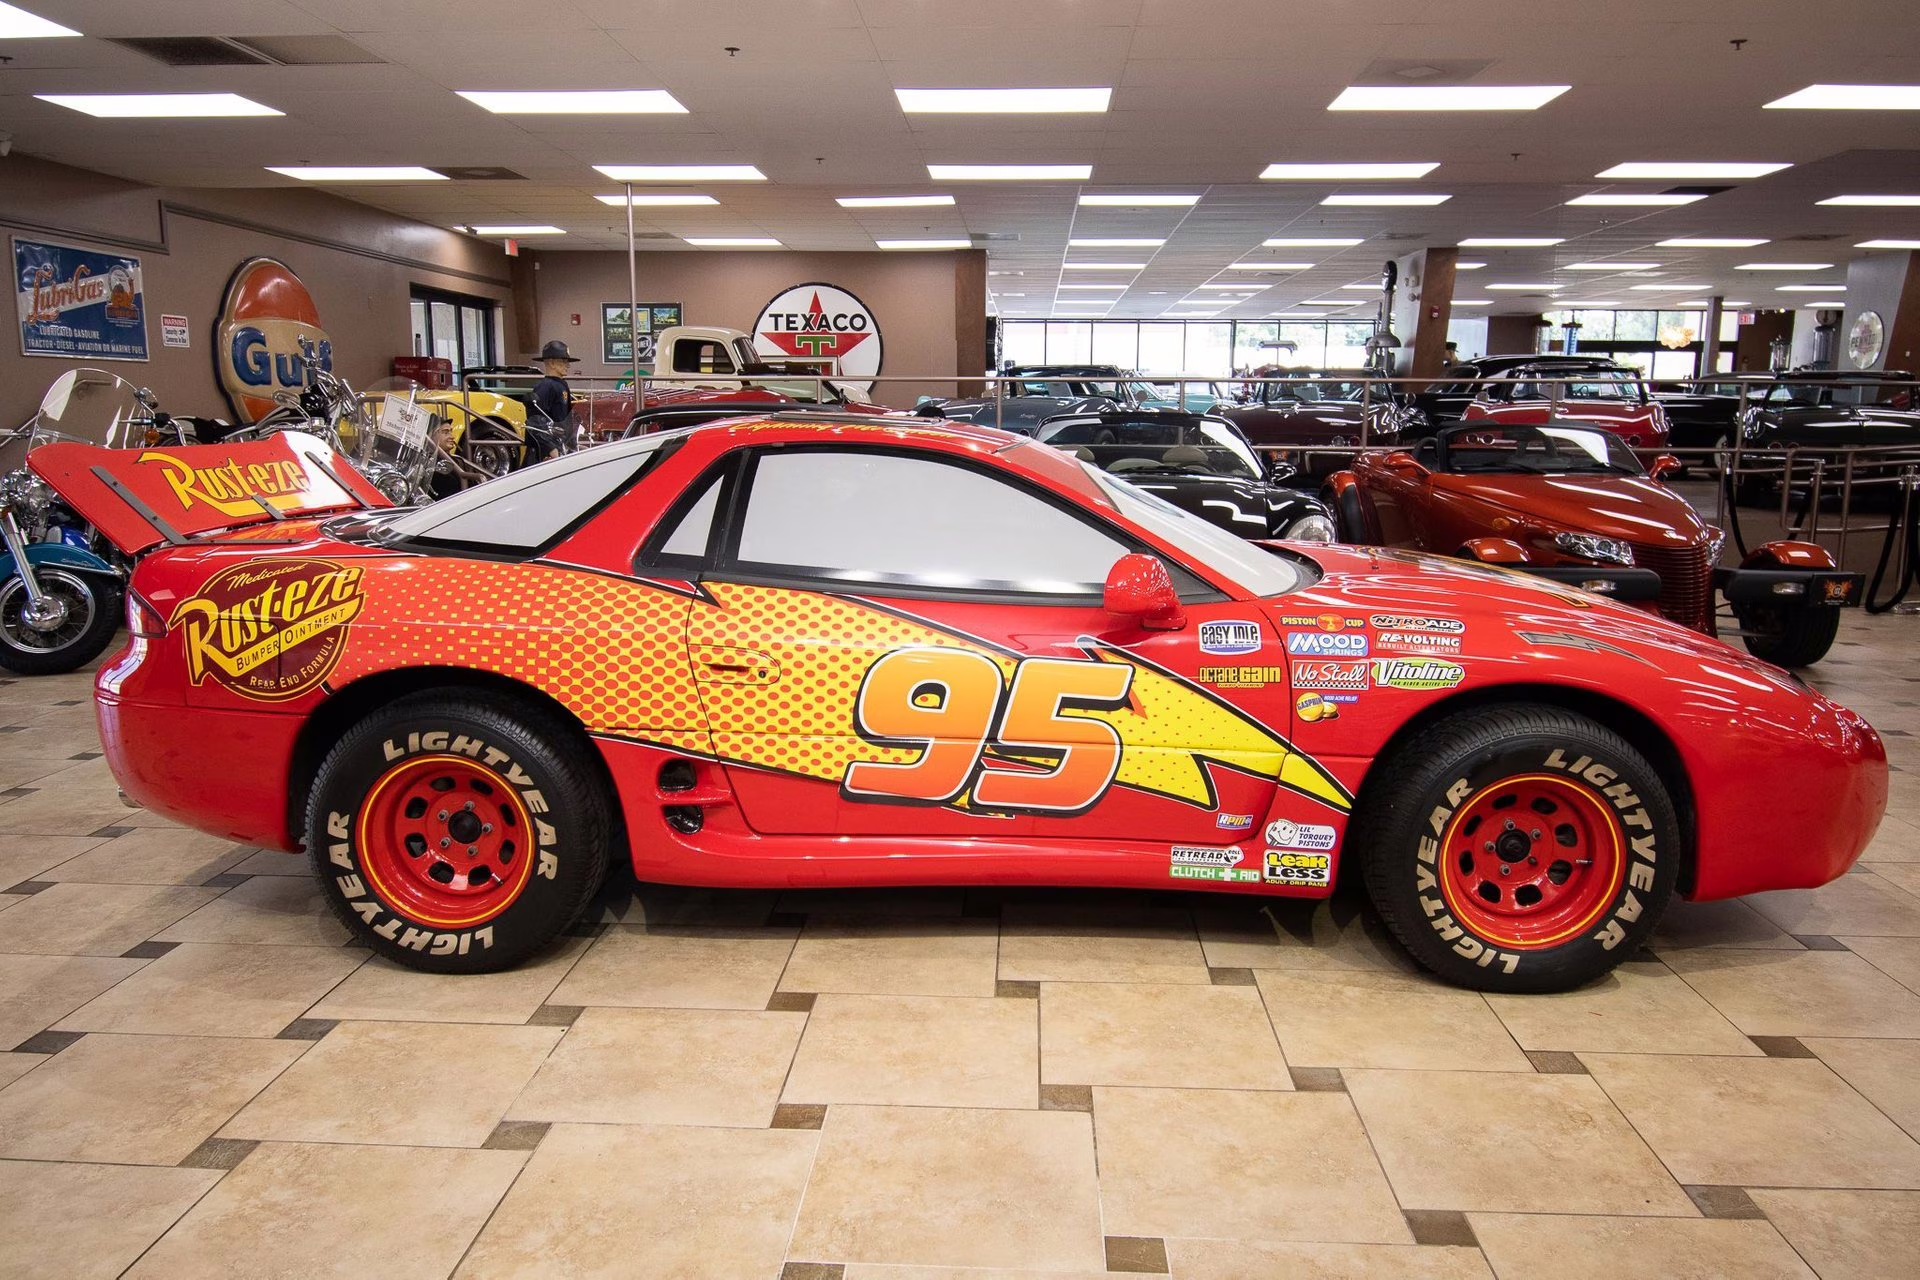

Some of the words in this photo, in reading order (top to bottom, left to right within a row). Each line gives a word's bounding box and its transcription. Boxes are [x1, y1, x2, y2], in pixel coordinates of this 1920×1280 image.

[768, 313, 867, 331] TEXACO
[39, 326, 72, 337] LUBRICATED
[74, 328, 100, 338] GASOLINE
[28, 339, 53, 348] TRACTOR
[56, 341, 75, 350] DIESEL
[78, 343, 101, 351] AVIATION
[103, 344, 110, 352] OR
[111, 345, 131, 354] MARINE
[132, 346, 144, 355] FUEL
[226, 563, 308, 592] Medicated
[1281, 617, 1317, 625] PISTON
[1346, 619, 1364, 627] CUP
[236, 640, 280, 671] BUMPER
[284, 608, 346, 644] OINTMENT
[1290, 633, 1366, 652] MOOD
[1380, 633, 1459, 647] RE-VOLTING
[1410, 645, 1459, 653] ALTERNATORS
[279, 674, 299, 689] END
[301, 636, 335, 679] FORMULA
[1375, 659, 1462, 685] Vitoline
[1295, 663, 1318, 681] No
[1318, 663, 1366, 682] Stall
[840, 646, 1135, 816] 95
[383, 731, 558, 881] LIGHTYEAR
[1298, 840, 1331, 848] PISTONS
[1299, 833, 1334, 841] TORQUEY
[1172, 850, 1223, 860] RETREAD
[1543, 749, 1657, 952] LIGHTYEAR
[327, 810, 494, 956] LIGHTYEAR
[1171, 866, 1216, 879] CLUTCH
[1239, 871, 1260, 881] AID
[1416, 777, 1521, 974] LIGHTYEAR
